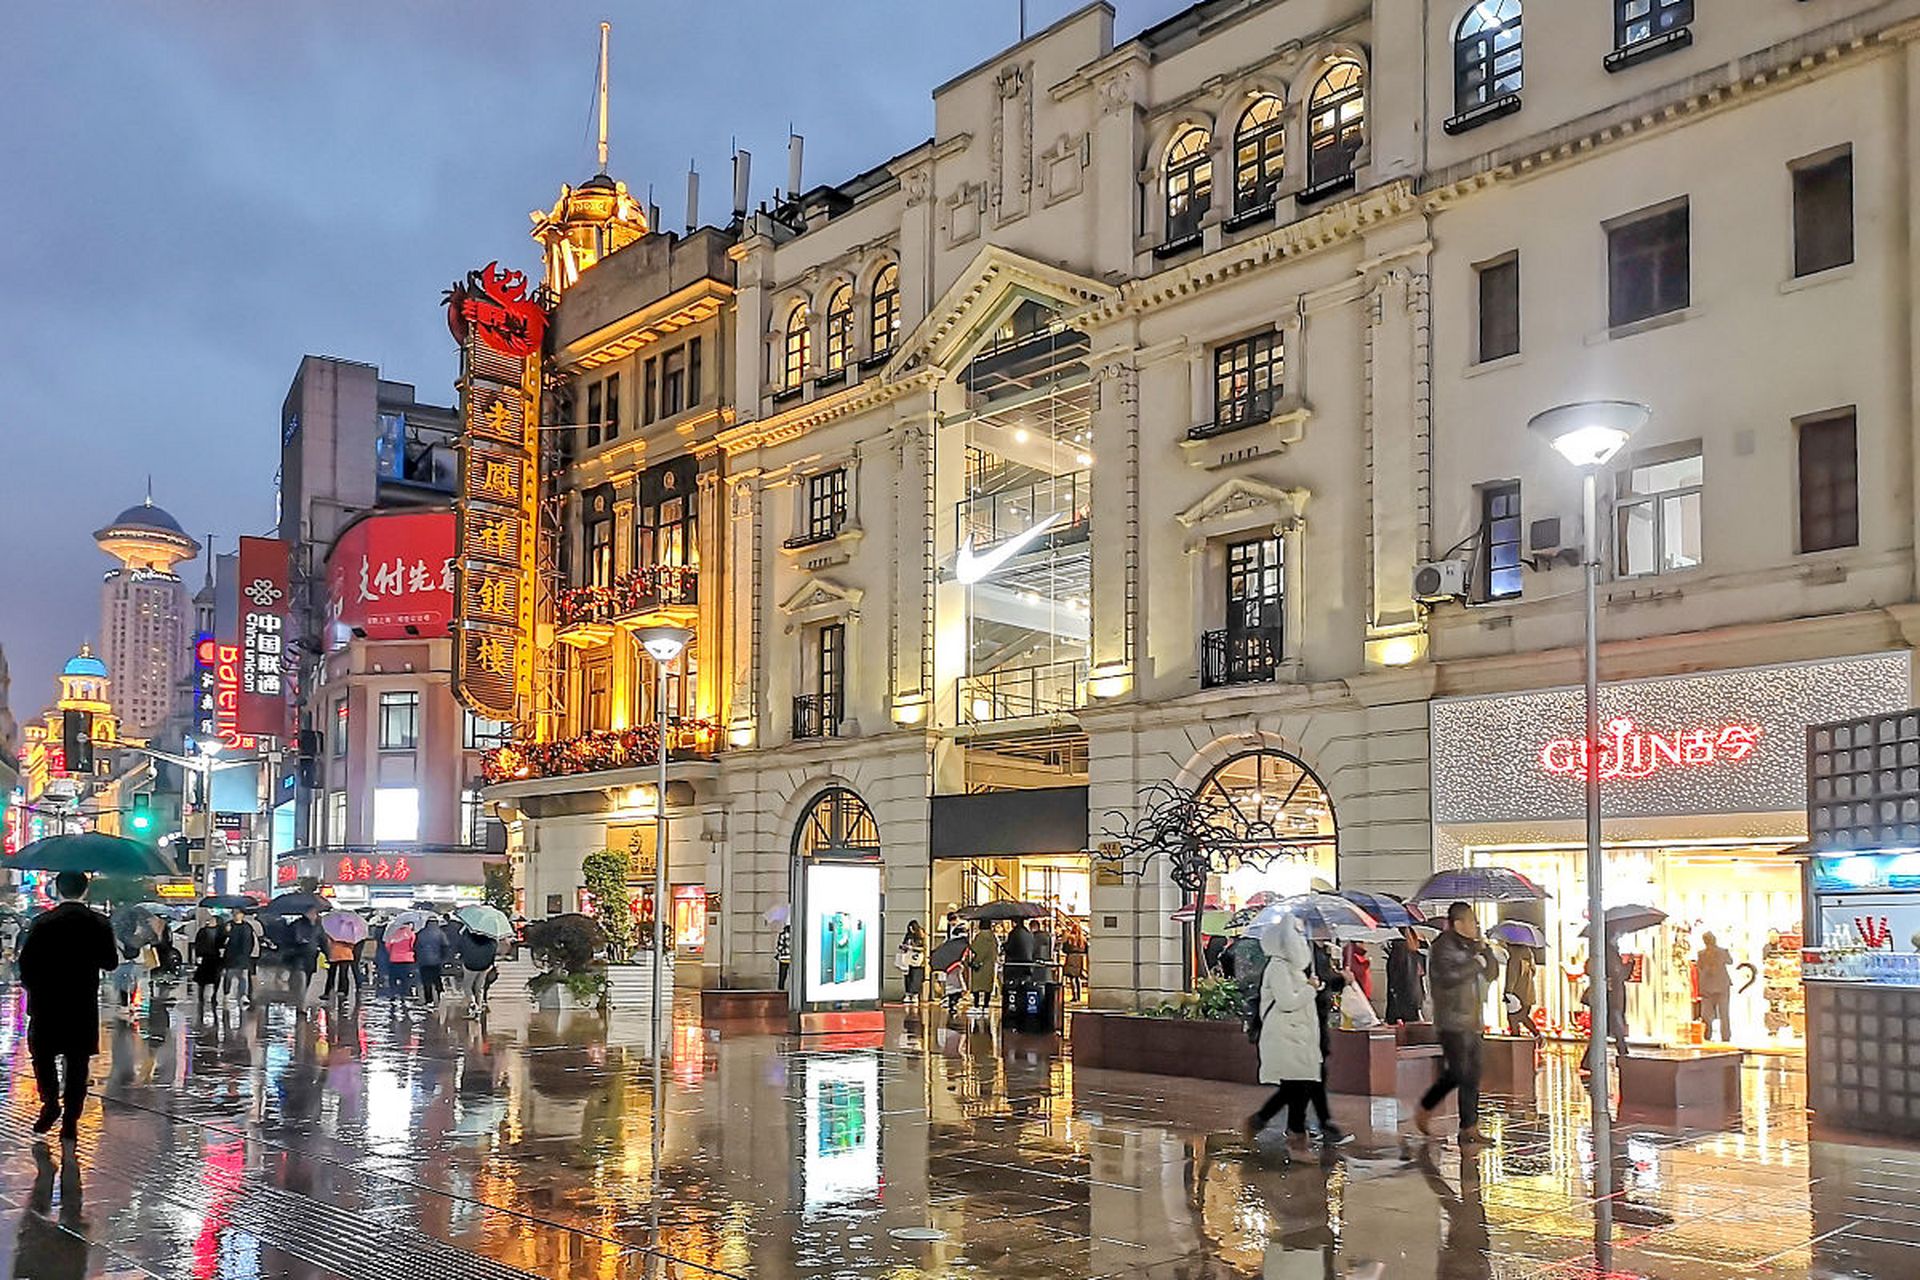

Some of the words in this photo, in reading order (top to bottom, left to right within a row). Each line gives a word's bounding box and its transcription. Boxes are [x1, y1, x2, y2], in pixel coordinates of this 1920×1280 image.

[257, 613, 282, 695] 中国联通
[1680, 725, 1763, 763] 古今
